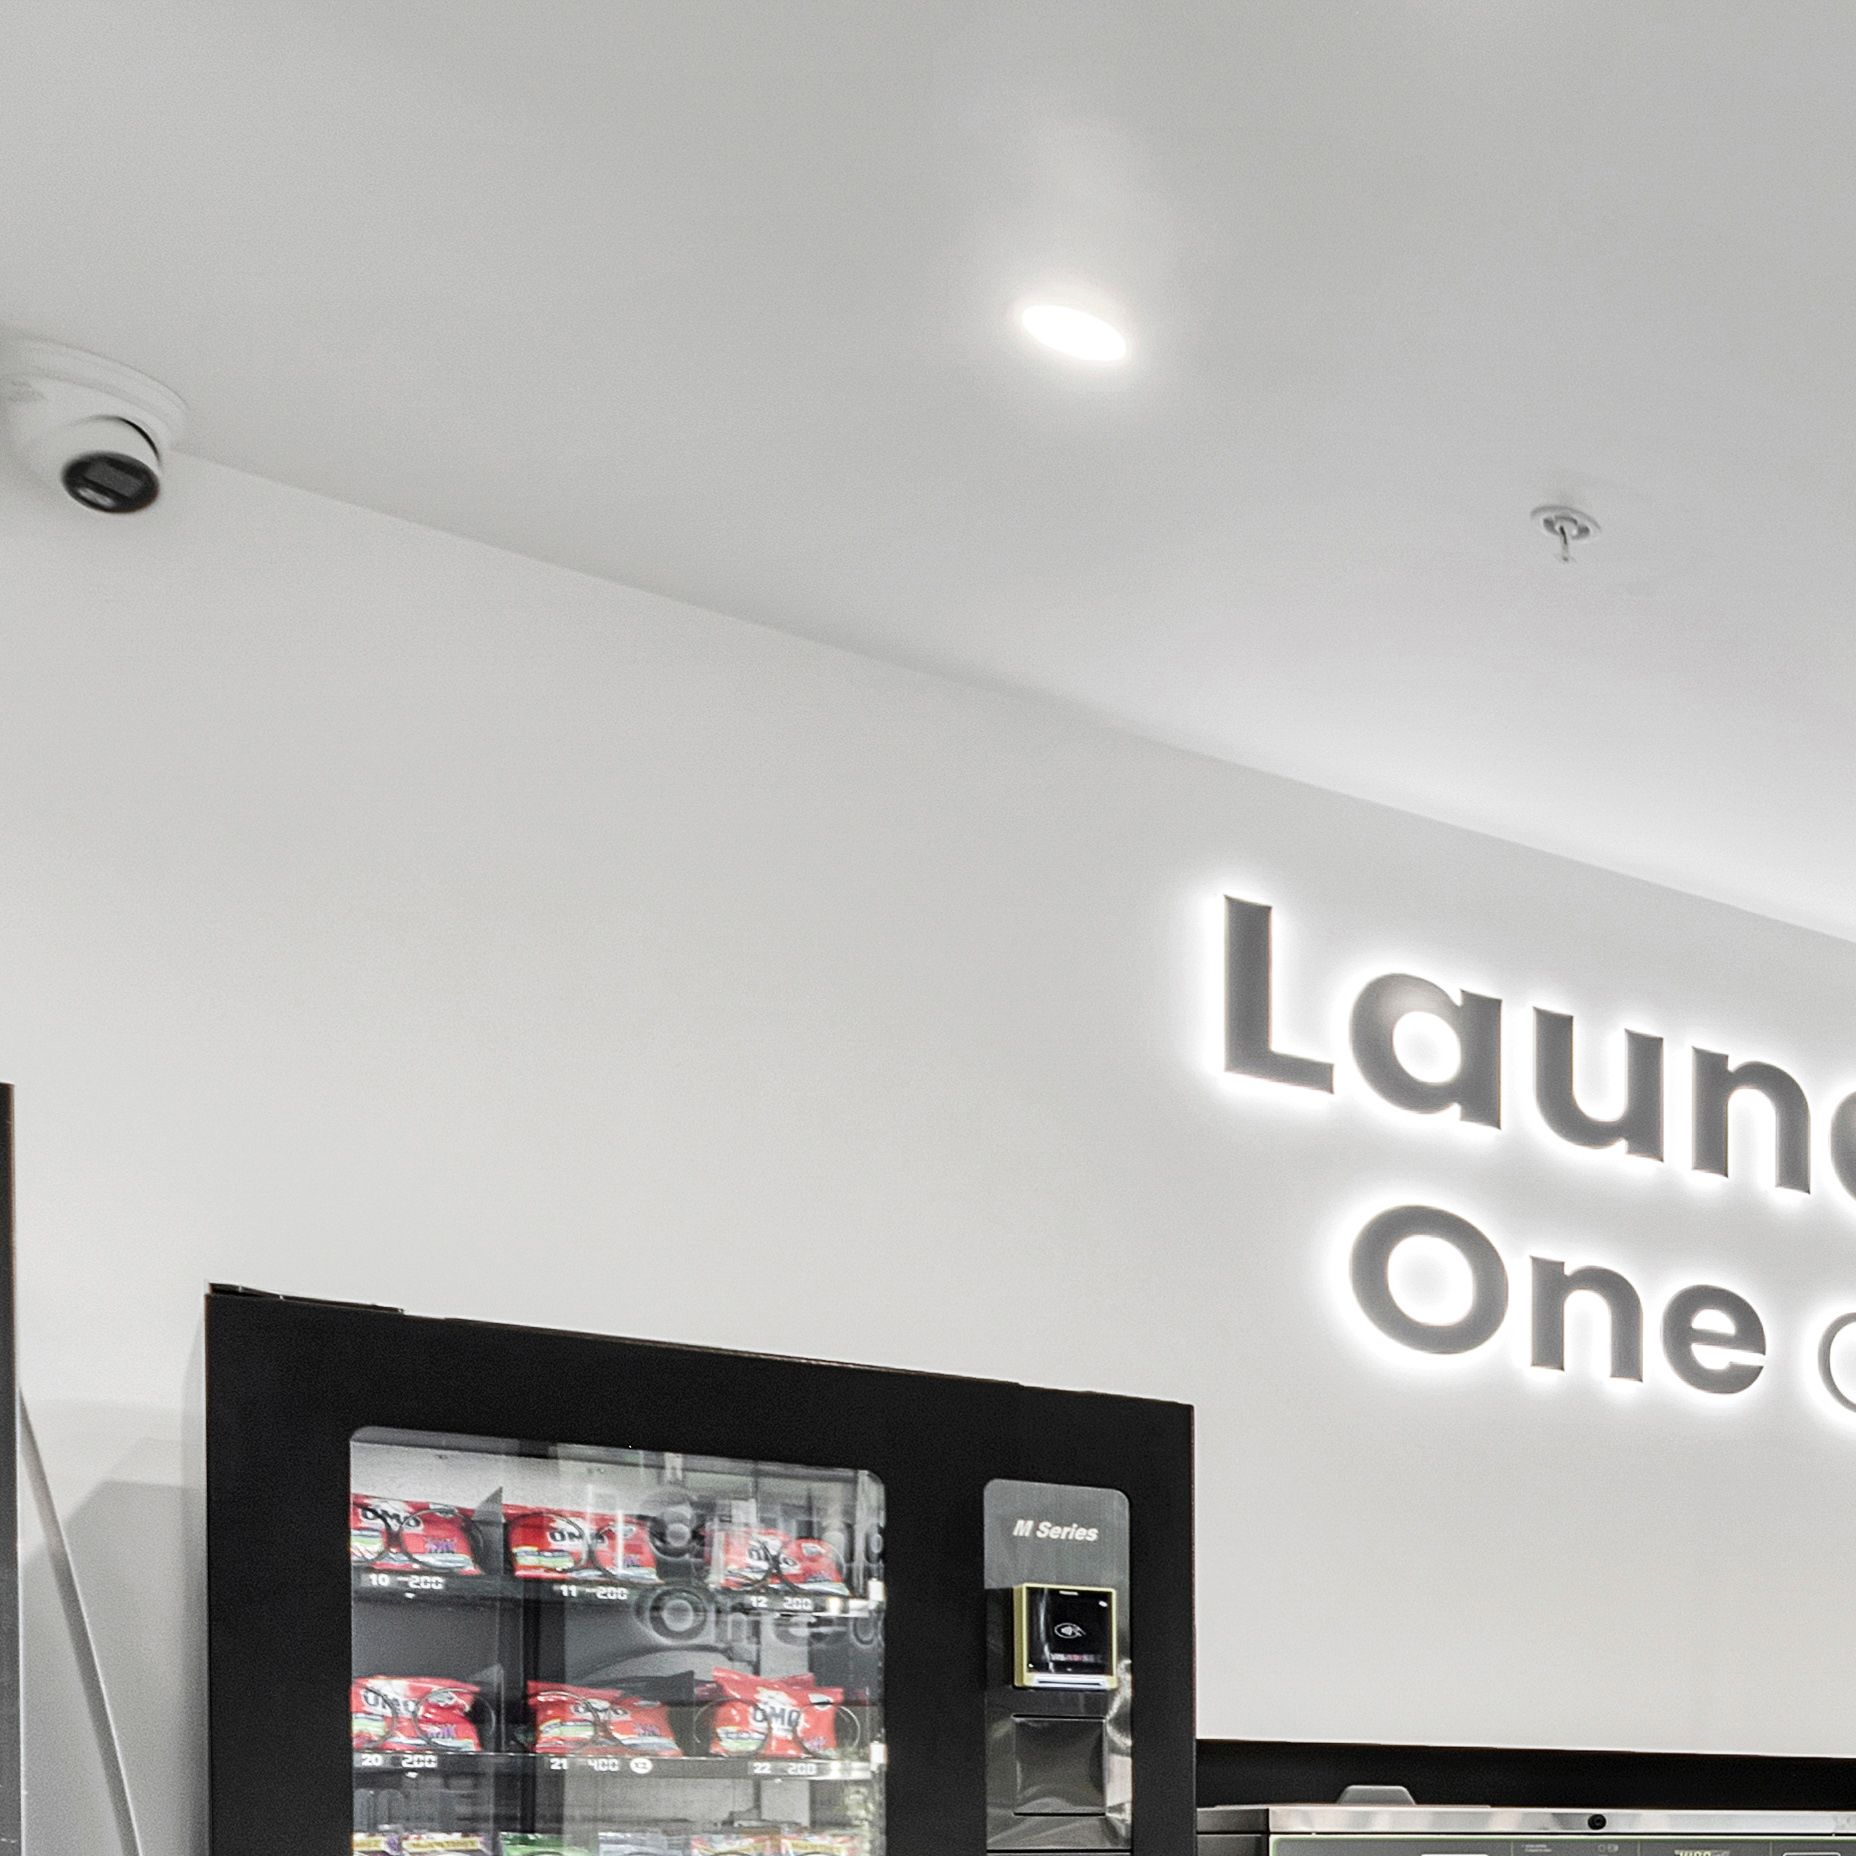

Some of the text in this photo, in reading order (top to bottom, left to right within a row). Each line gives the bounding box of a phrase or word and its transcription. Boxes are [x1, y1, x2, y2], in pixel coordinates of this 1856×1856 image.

[1350, 1203, 1767, 1396] One
[1013, 1519, 1099, 1542] M Series
[368, 1573, 390, 1587] 10
[560, 1584, 577, 1598] 11
[361, 1754, 383, 1767] 20
[550, 1757, 568, 1770] 21
